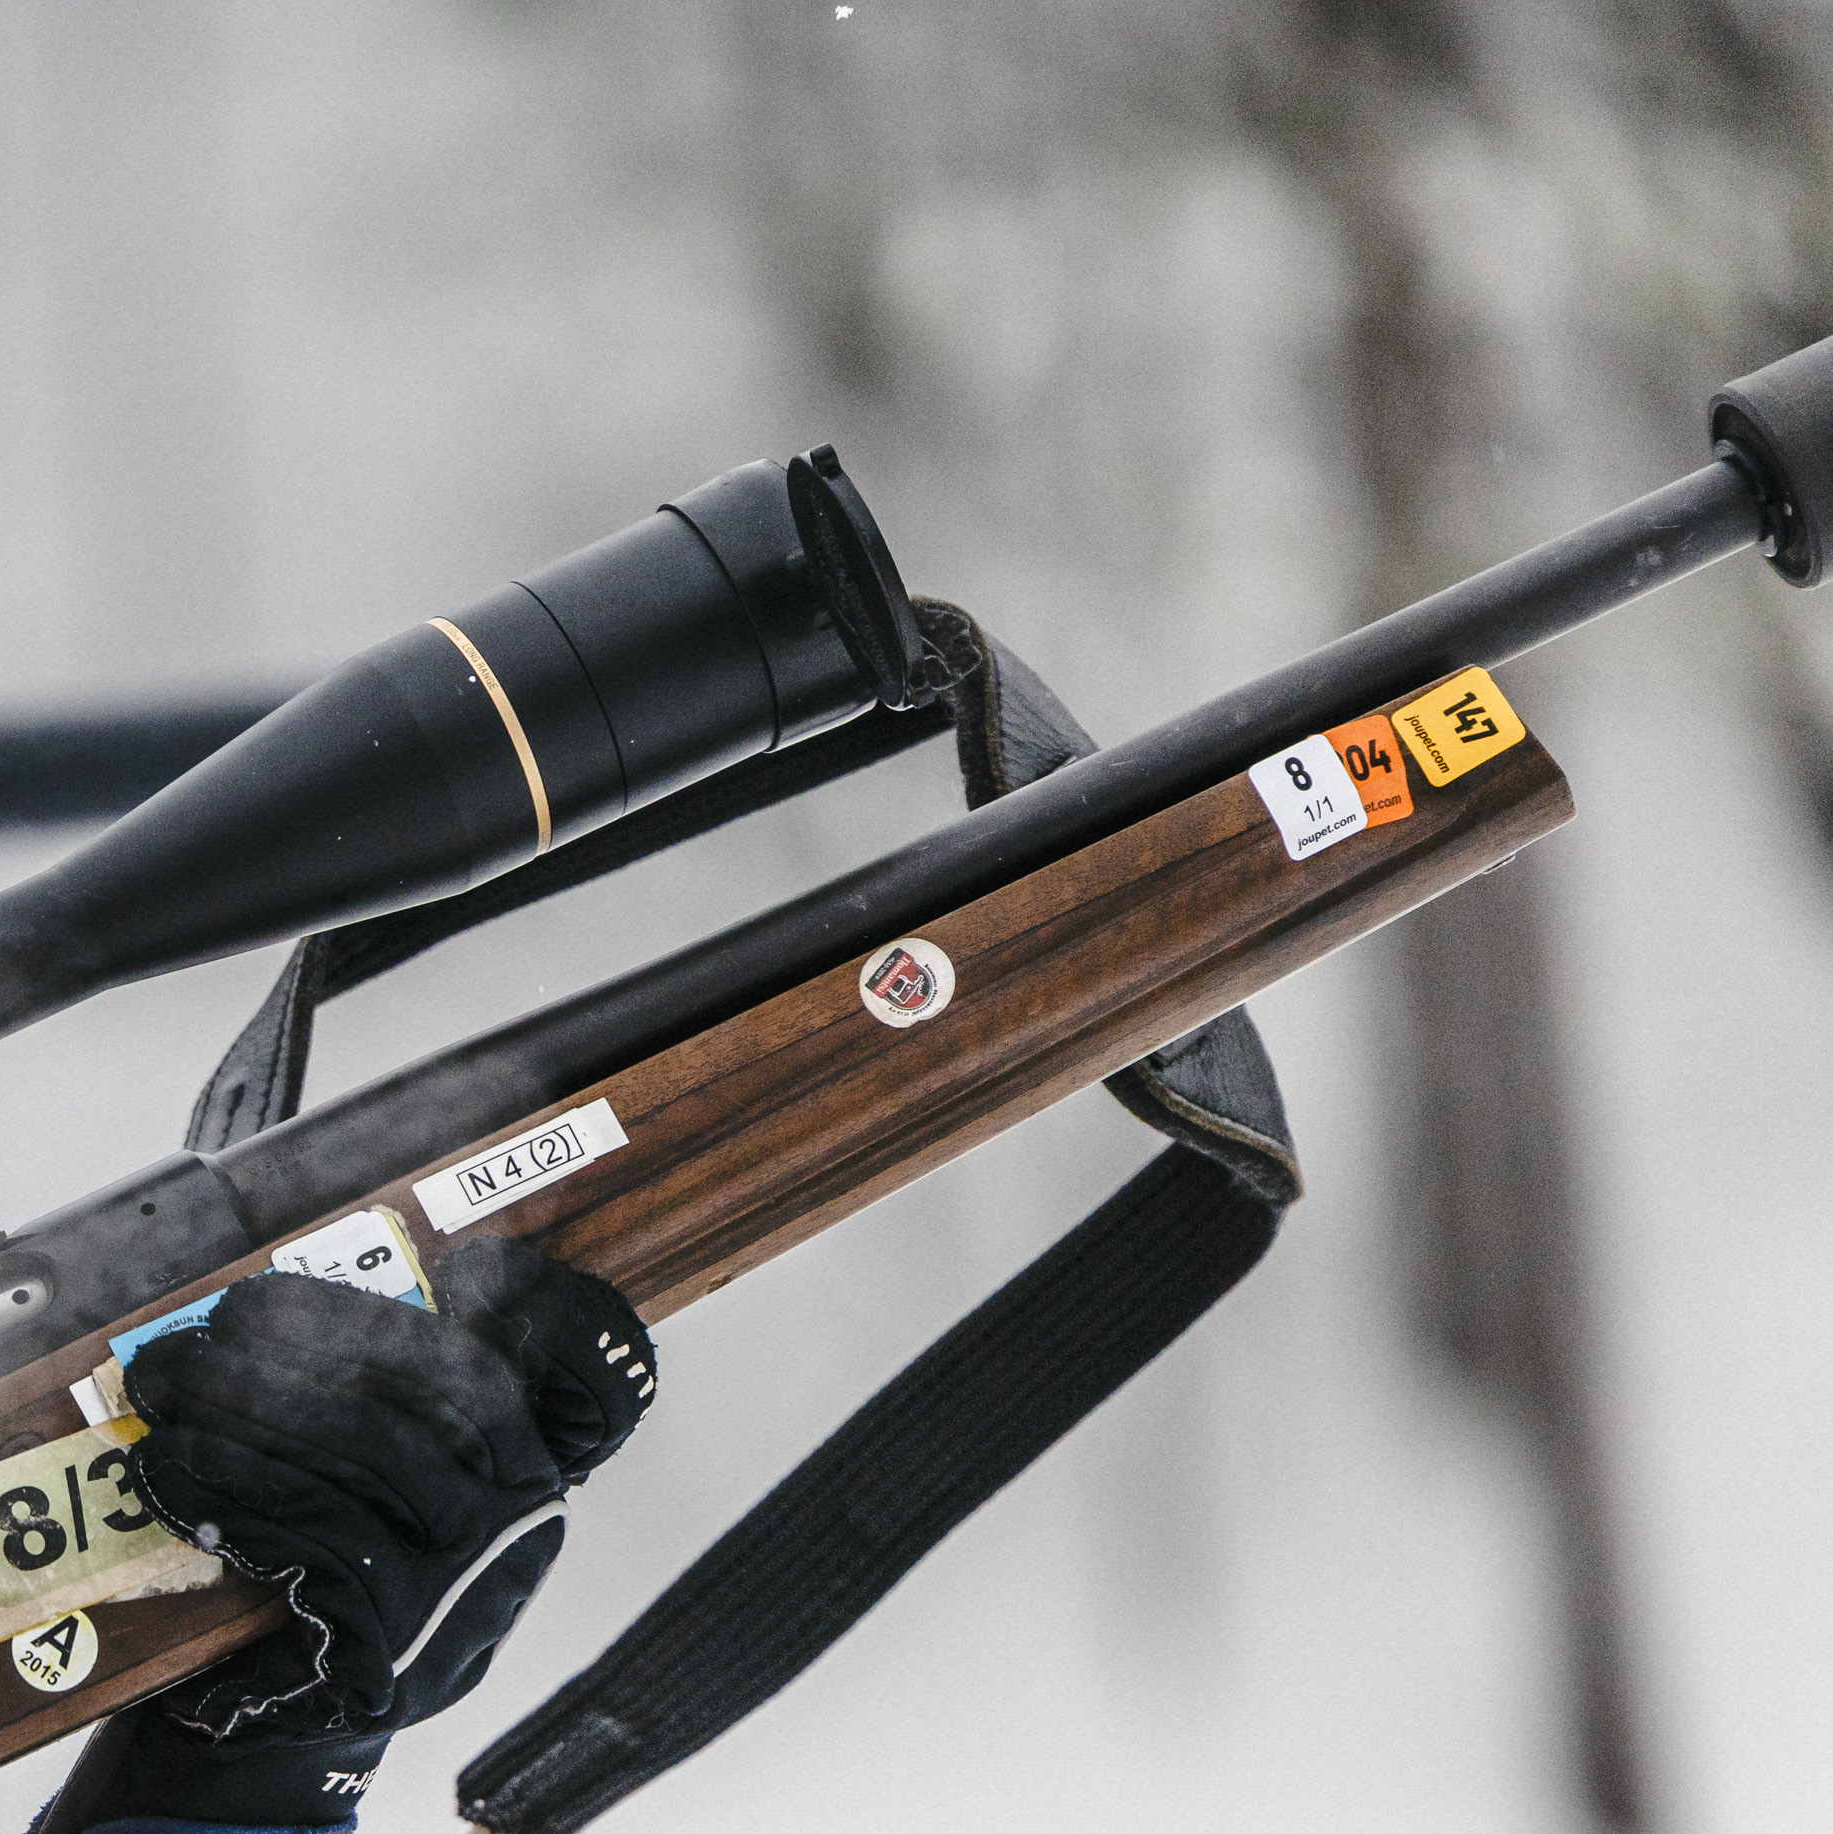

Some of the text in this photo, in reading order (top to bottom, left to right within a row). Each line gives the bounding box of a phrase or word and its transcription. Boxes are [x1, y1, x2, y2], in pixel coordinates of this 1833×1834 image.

[461, 643, 499, 691] LONG RANGE
[1442, 690, 1501, 745] 147
[1334, 738, 1392, 782] 04
[1403, 713, 1451, 775] joupet.com
[1284, 756, 1313, 792] 8
[1303, 795, 1335, 822] 1/1
[1296, 812, 1358, 852] joupet.com
[467, 1166, 497, 1197] N
[505, 1154, 522, 1179] 4
[30, 1614, 80, 1671] A
[19, 1650, 62, 1686] 2015
